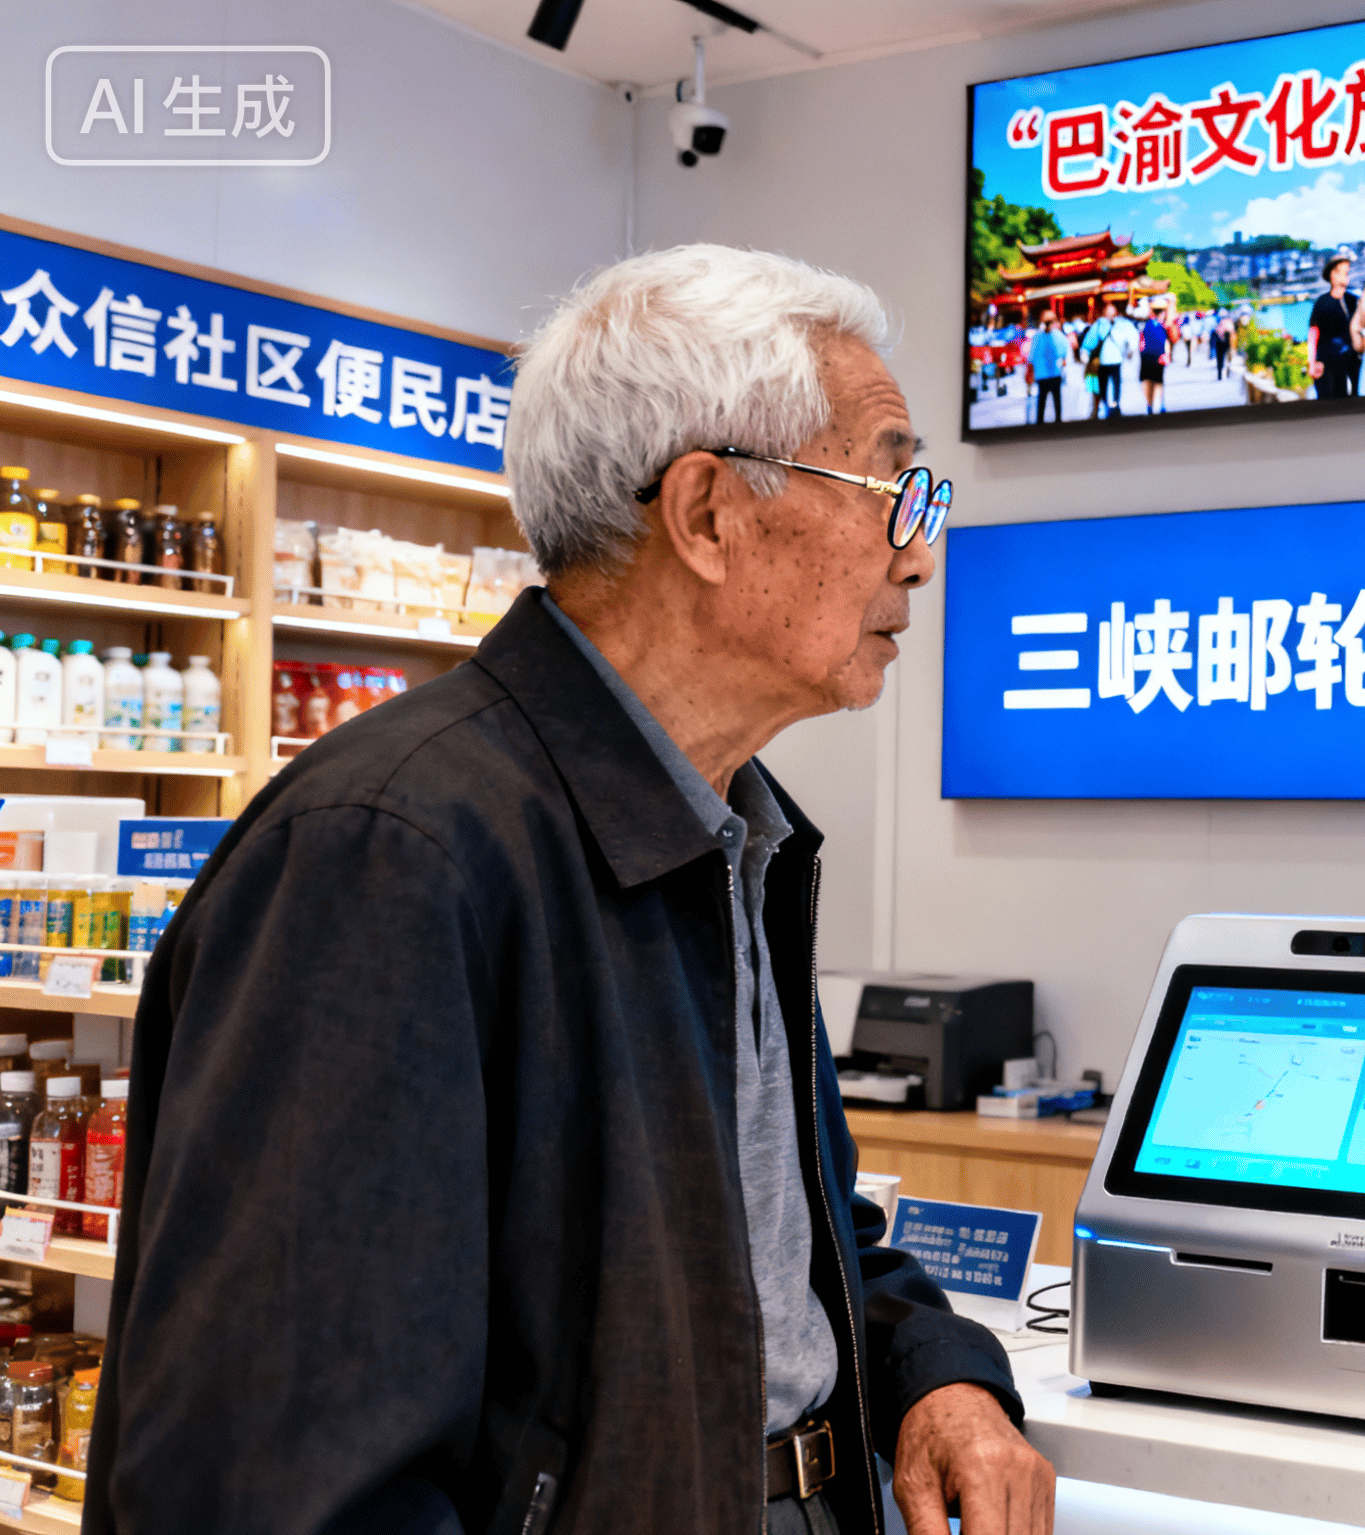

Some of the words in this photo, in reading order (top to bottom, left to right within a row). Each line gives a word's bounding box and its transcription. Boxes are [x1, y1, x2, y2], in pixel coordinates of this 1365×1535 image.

[0, 268, 515, 450] 众信社区便民店
